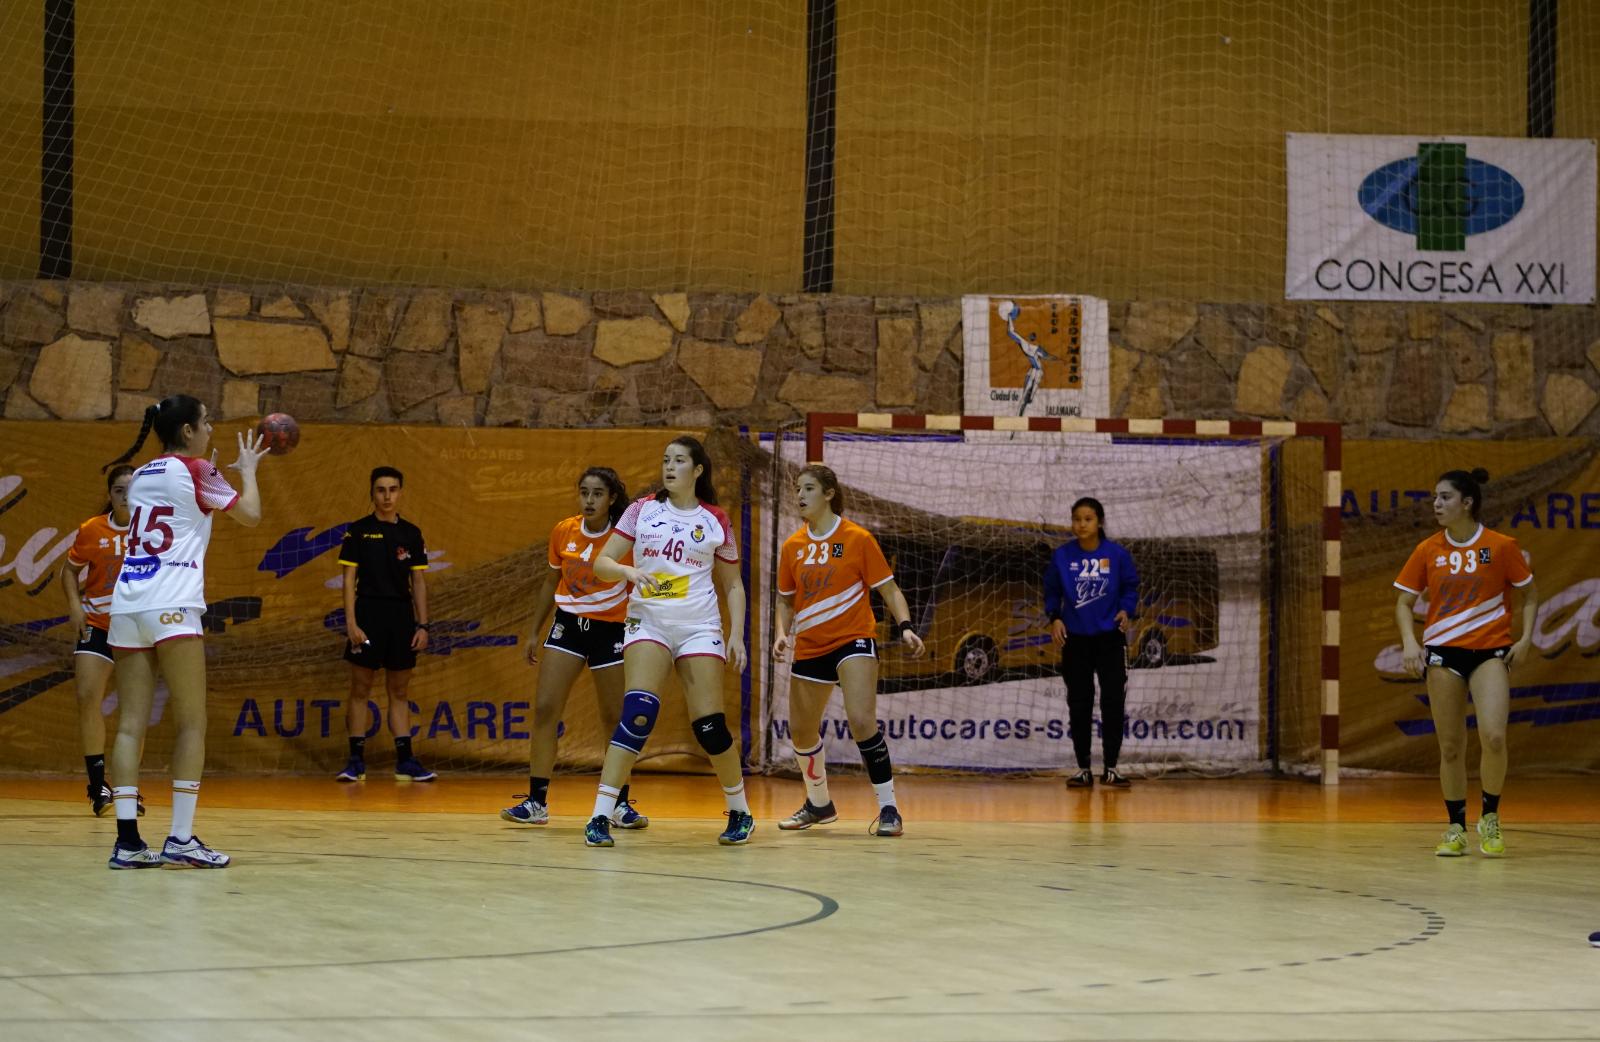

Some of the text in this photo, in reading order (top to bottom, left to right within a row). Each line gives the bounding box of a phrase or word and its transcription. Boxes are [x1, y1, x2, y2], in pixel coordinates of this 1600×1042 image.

[1314, 259, 1565, 294] CONGESA XXI
[127, 506, 175, 556] 45
[580, 543, 593, 561] 4
[662, 538, 685, 563] 46
[804, 542, 829, 565] 23
[1449, 549, 1477, 575] 93
[1079, 558, 1100, 577] 22
[1075, 578, 1109, 606] Gil
[160, 612, 184, 625] GO
[233, 699, 566, 740] AUTARE
